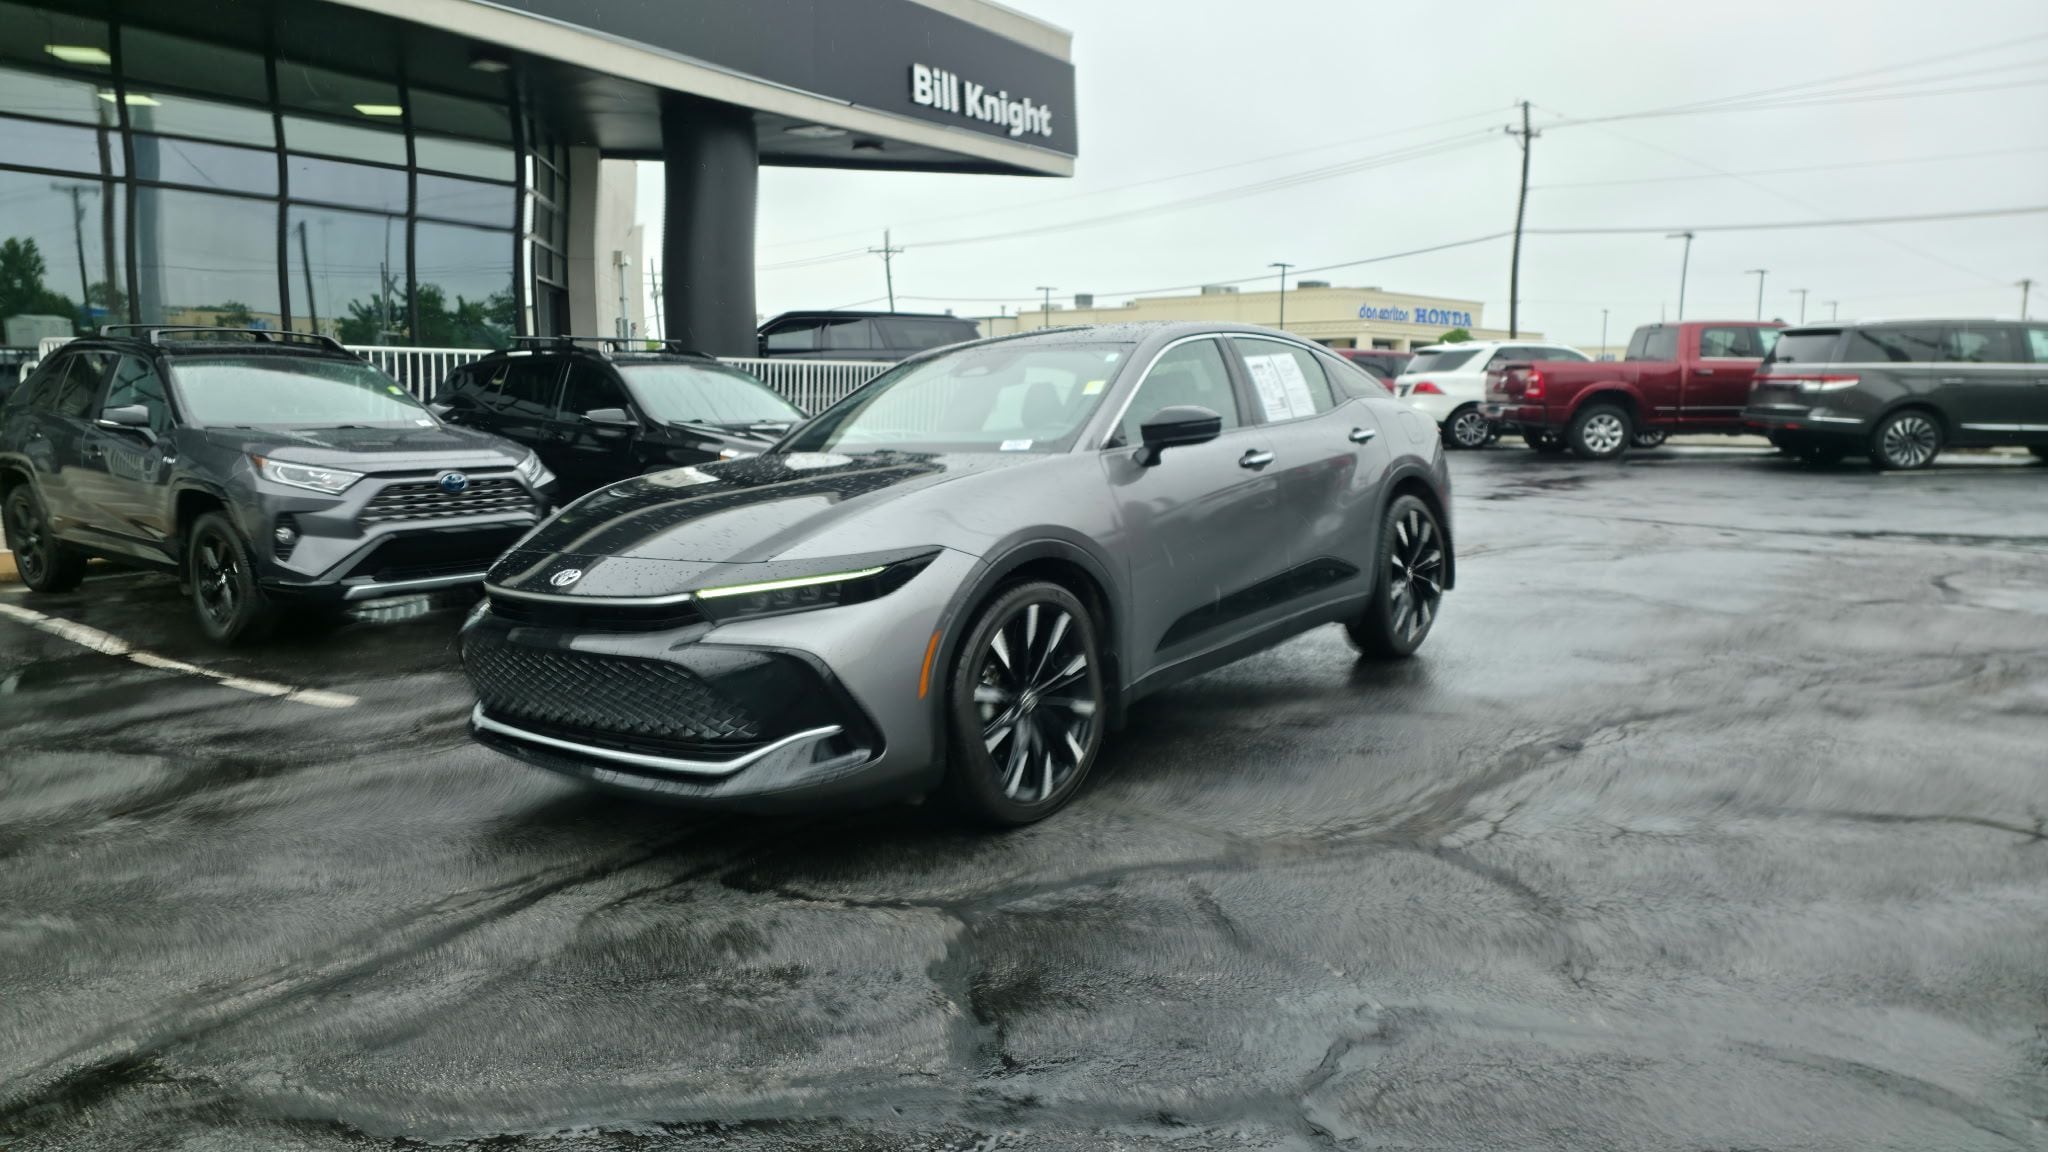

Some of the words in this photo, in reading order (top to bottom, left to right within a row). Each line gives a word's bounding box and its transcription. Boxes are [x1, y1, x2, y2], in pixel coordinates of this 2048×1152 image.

[913, 63, 960, 114] Bill
[965, 81, 1052, 137] Knight
[1415, 307, 1472, 327] HONDA
